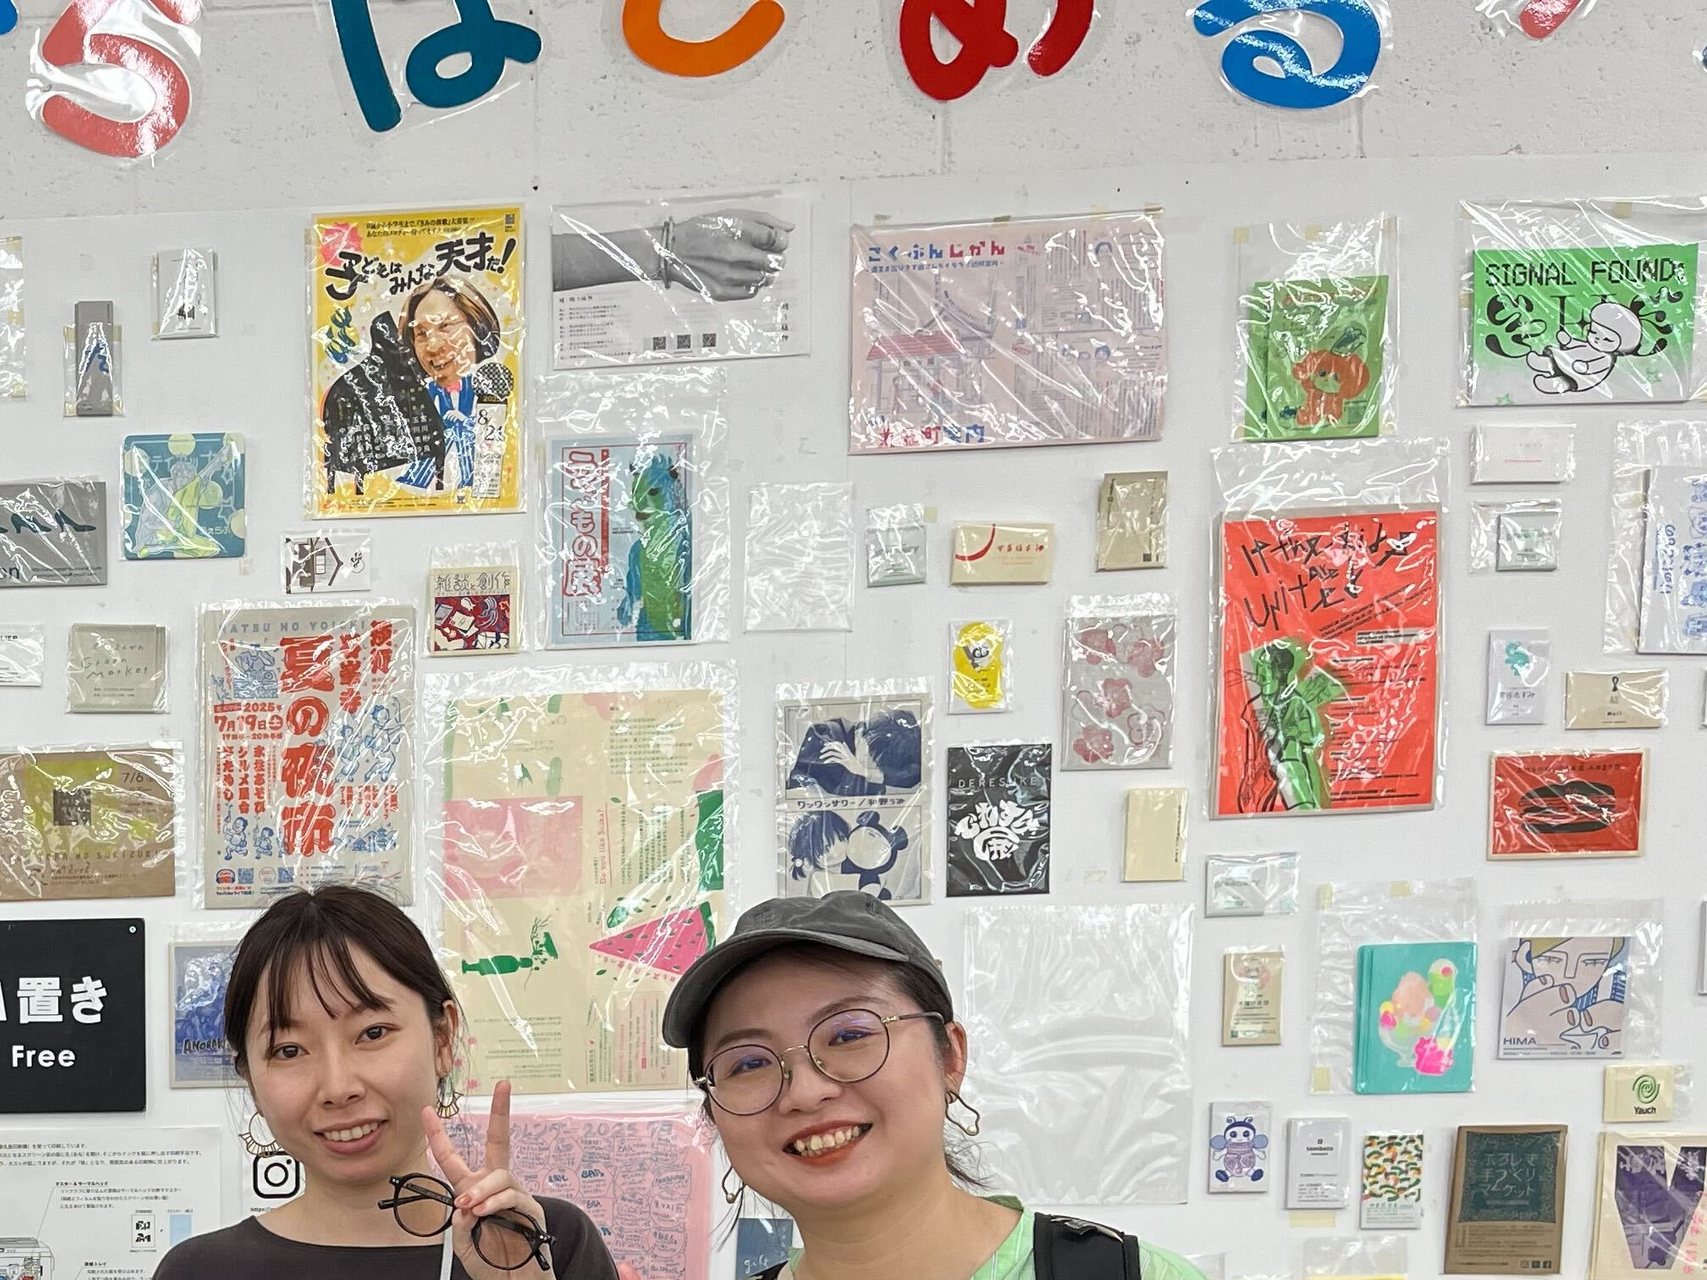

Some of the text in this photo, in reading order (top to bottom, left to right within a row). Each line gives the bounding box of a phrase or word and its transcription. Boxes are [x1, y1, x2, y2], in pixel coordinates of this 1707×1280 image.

[1484, 261, 1577, 287] SIGNAL
[435, 573, 511, 592] 雑談と創作
[280, 621, 300, 633] NO
[1503, 1036, 1537, 1046] HIMA
[11, 1044, 76, 1068] Free
[1633, 1106, 1657, 1115] Yauch
